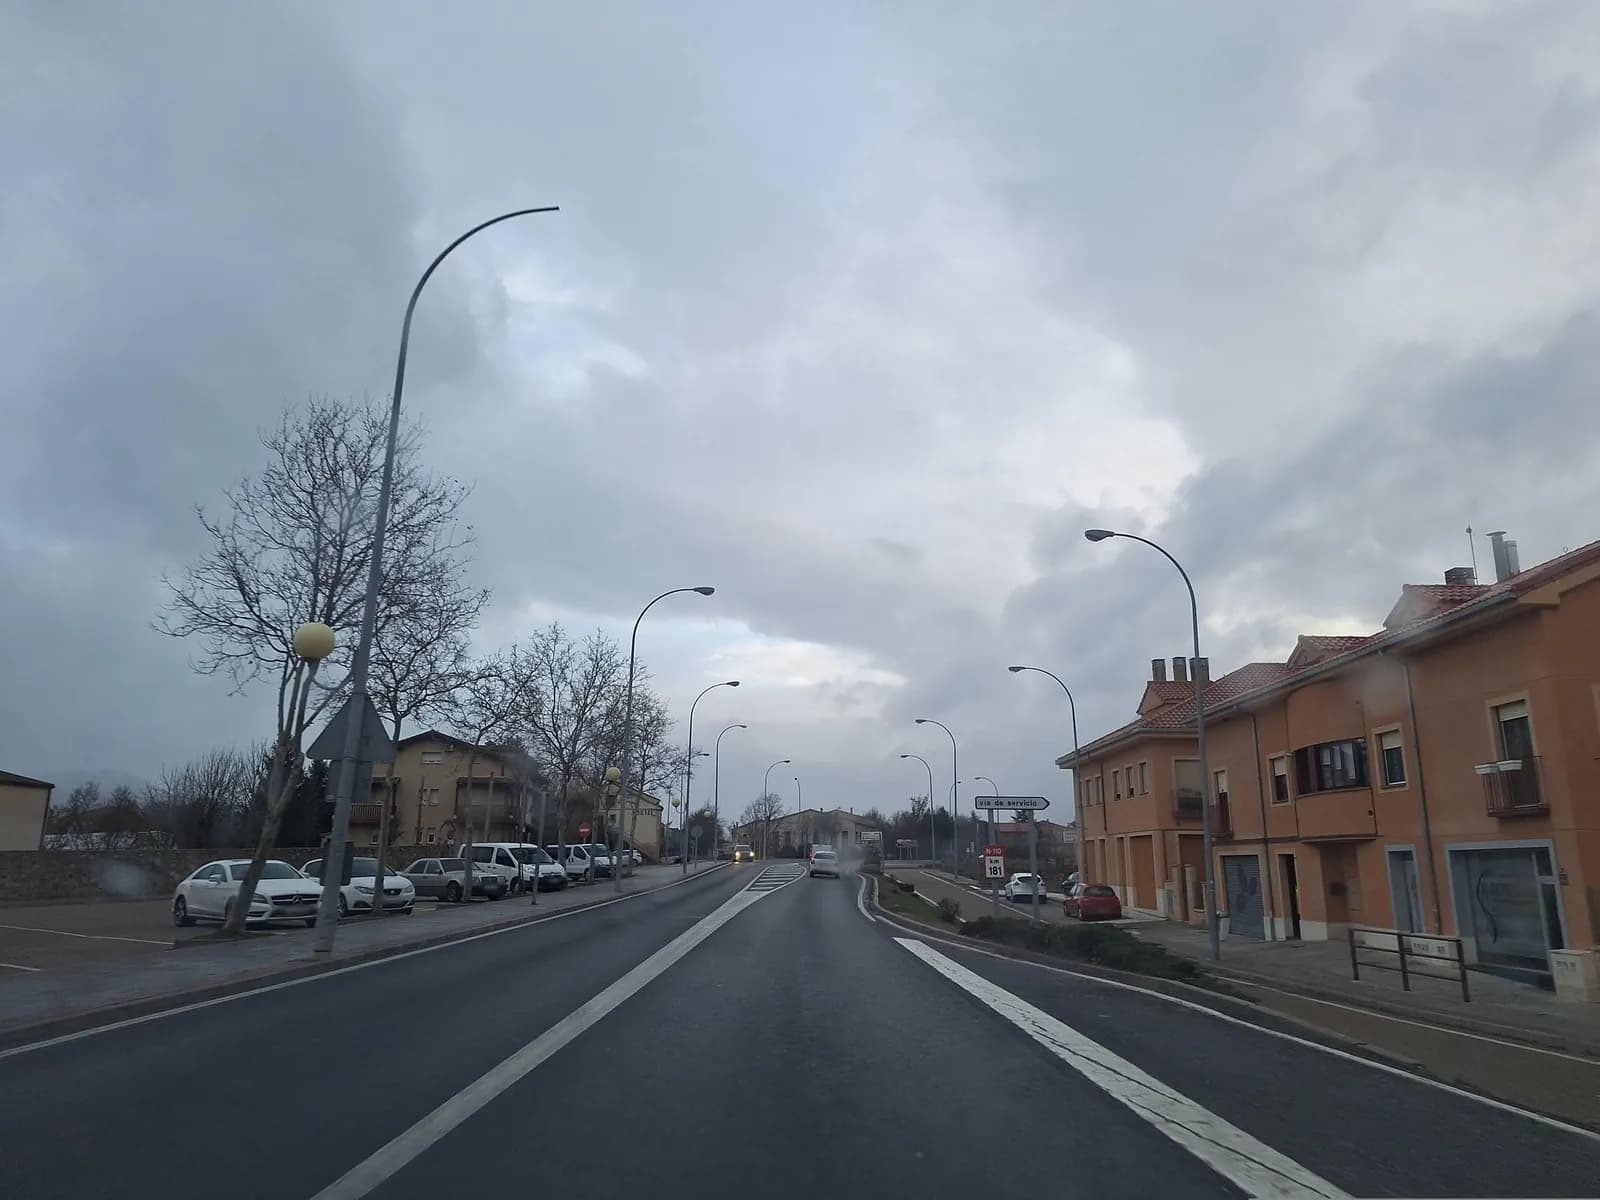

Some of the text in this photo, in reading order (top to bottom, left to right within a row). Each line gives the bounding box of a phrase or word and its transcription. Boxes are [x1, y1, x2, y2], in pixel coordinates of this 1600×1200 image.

[994, 799, 1004, 807] de
[1007, 799, 1037, 807] servicio
[989, 866, 1002, 875] 181
